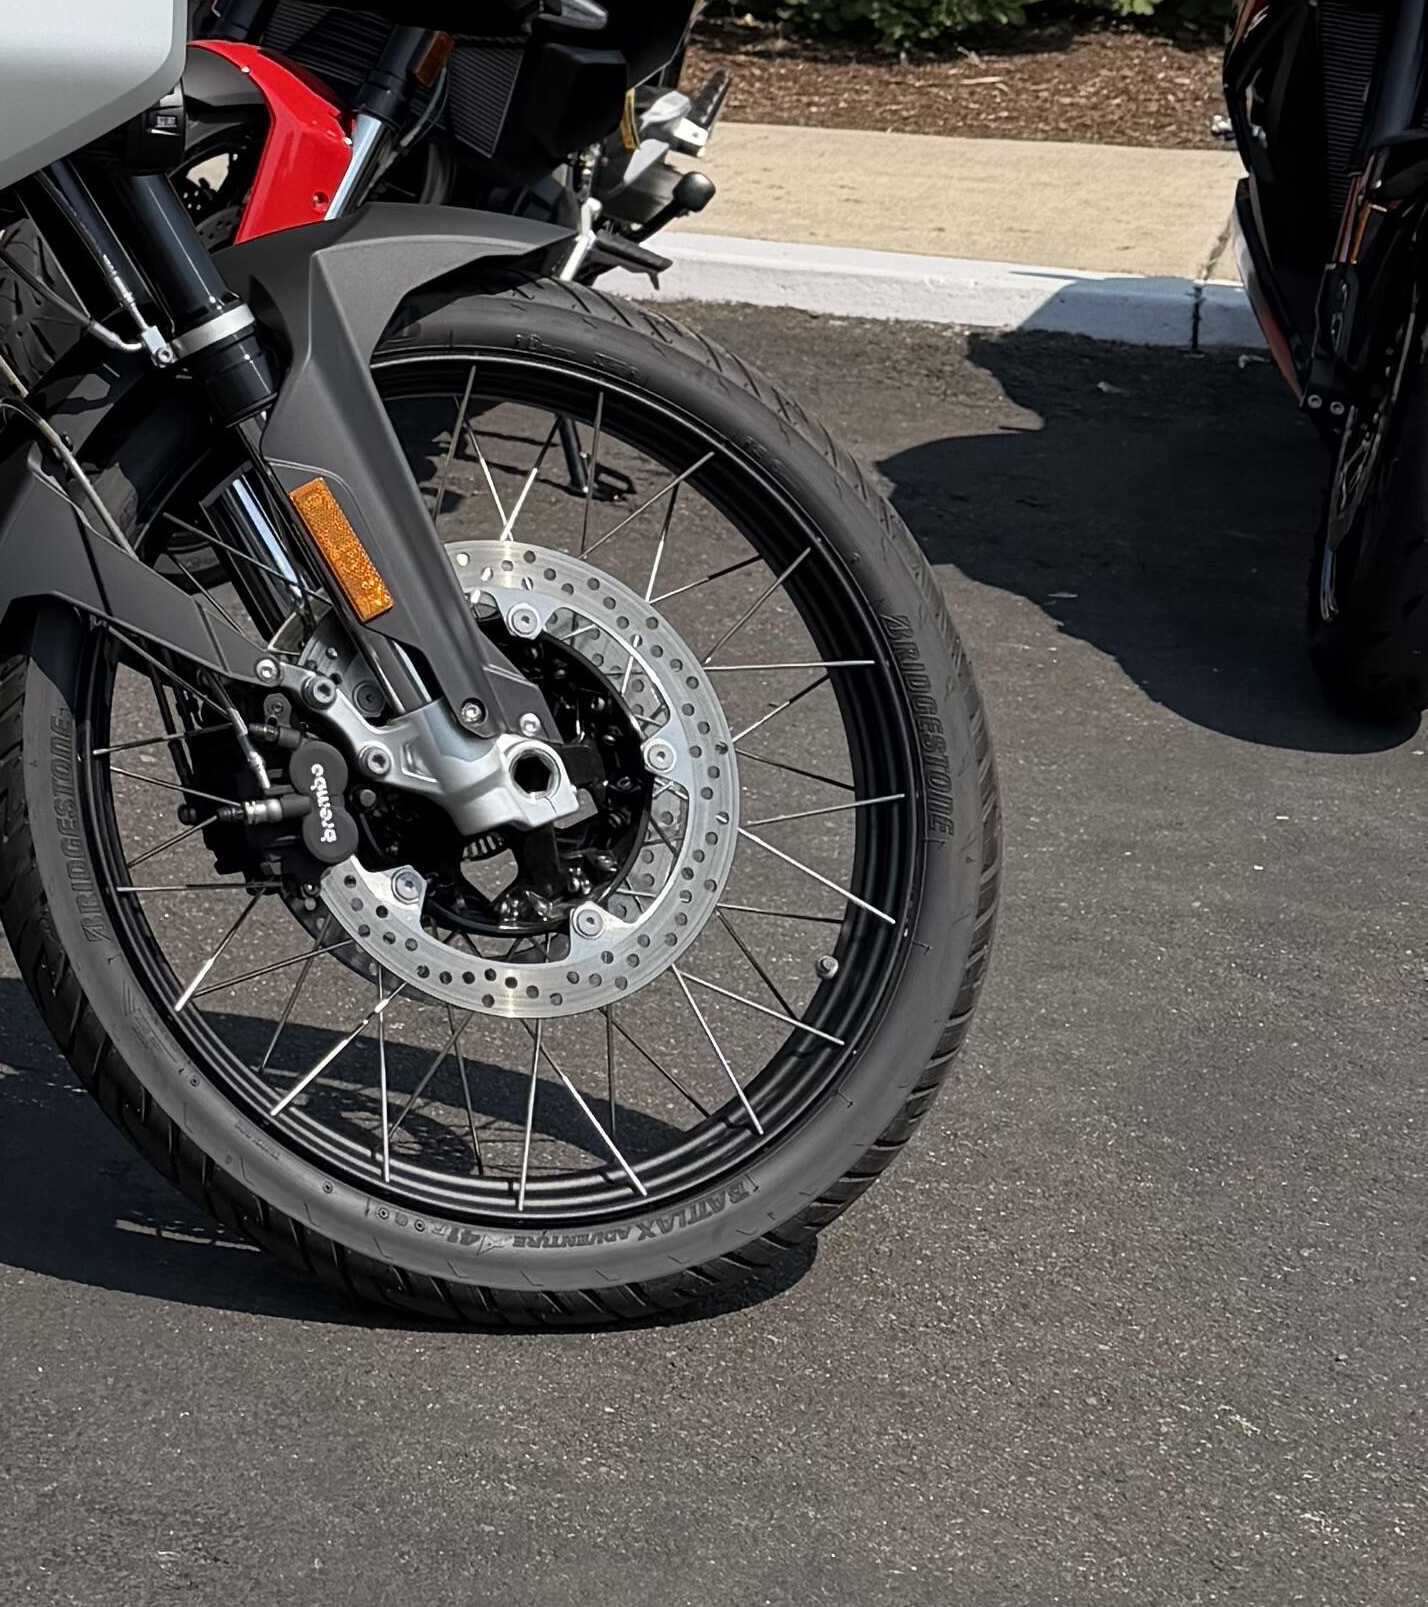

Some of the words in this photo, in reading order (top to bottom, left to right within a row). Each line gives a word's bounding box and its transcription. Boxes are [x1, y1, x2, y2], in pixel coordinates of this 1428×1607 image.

[48, 713, 114, 944] BRIDGESTONE
[310, 762, 338, 844] brembo
[511, 1225, 632, 1249] ADVENTURE
[634, 1178, 750, 1242] BATTLAX
